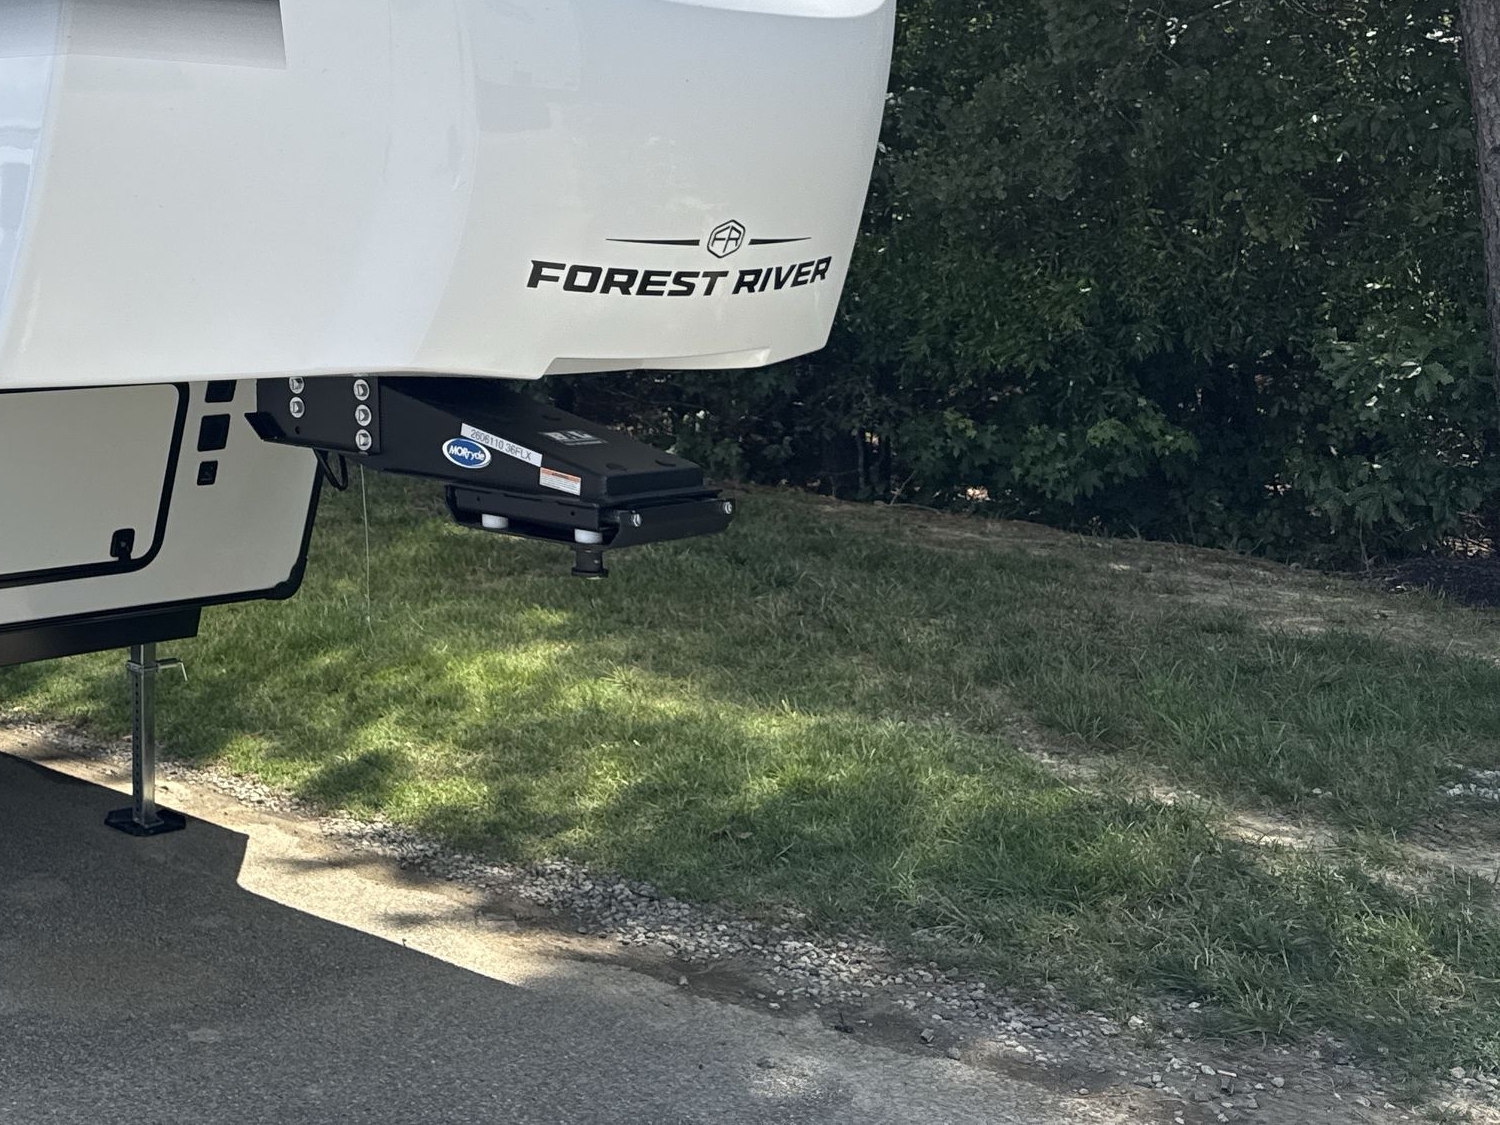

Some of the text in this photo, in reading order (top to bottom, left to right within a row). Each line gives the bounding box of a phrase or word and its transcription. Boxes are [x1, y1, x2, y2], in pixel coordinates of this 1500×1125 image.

[526, 256, 833, 297] FOREST RIVER
[505, 443, 532, 461] 36FLX
